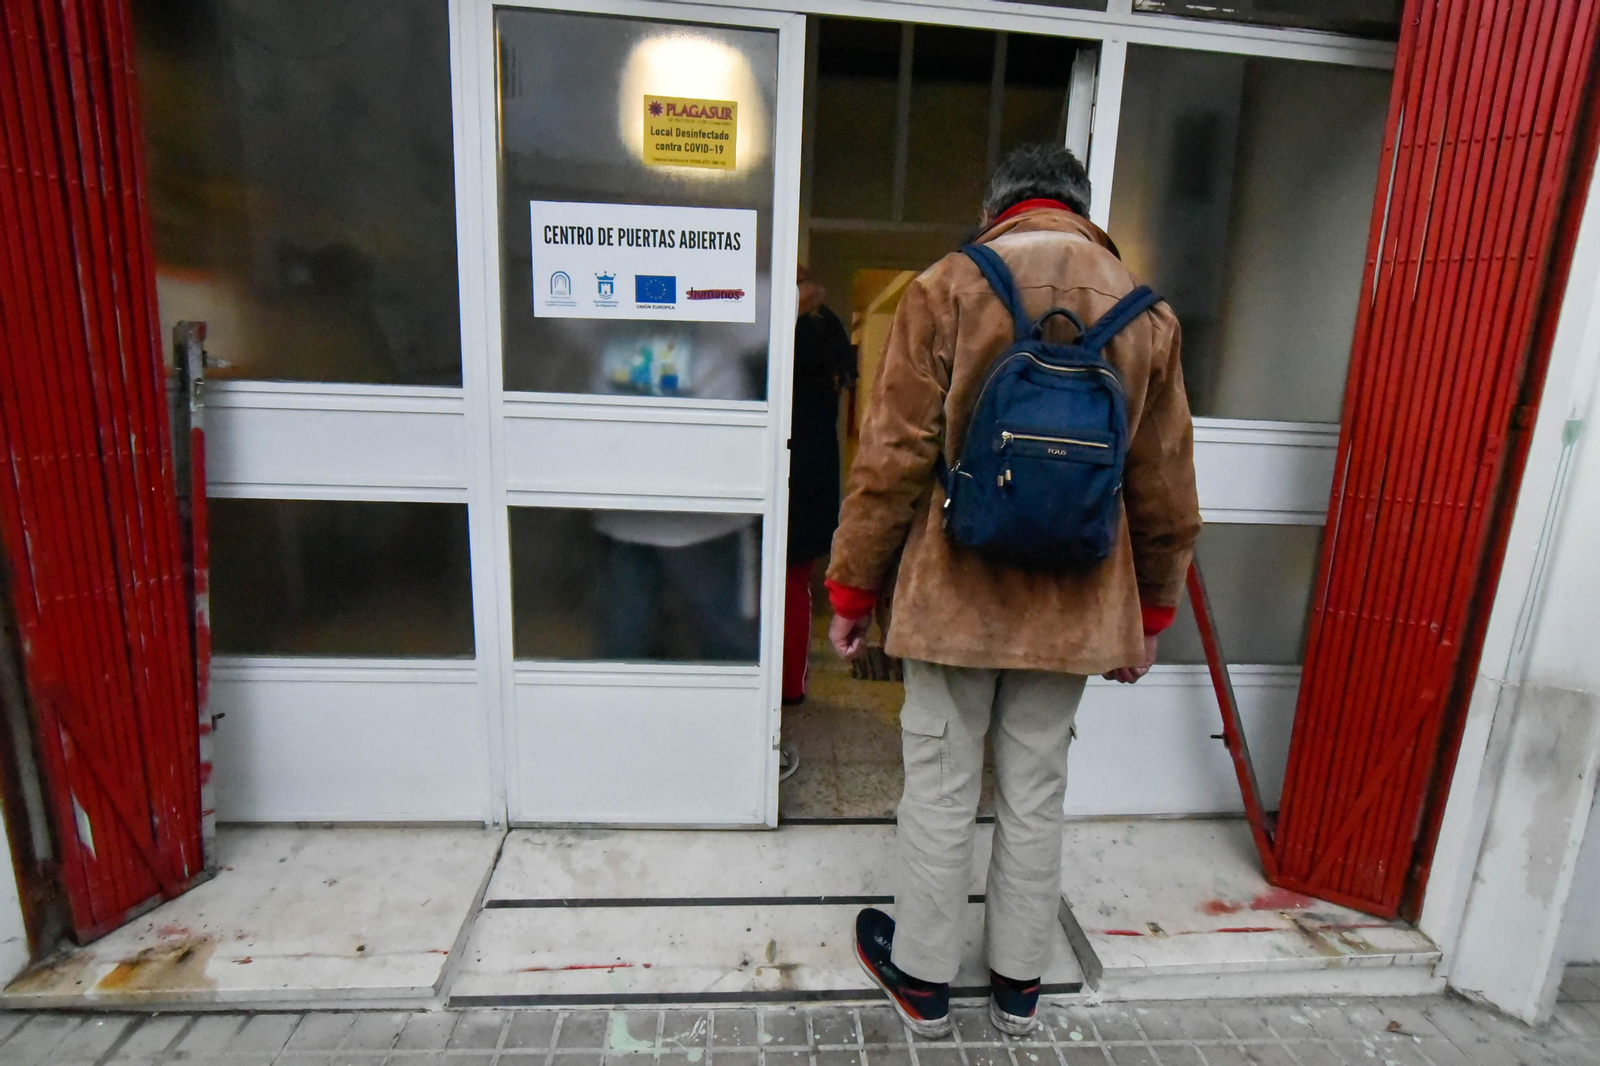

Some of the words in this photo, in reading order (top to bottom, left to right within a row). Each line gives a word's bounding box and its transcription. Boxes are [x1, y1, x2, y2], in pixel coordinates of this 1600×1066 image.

[665, 103, 733, 120] PLAGASUR
[650, 125, 673, 137] Local
[675, 127, 730, 140] Desinfectado
[655, 142, 682, 152] contra
[684, 143, 724, 154] COVID-19
[543, 225, 594, 246] CENTRO
[597, 227, 614, 246] DE
[618, 227, 676, 249] PUERTAS
[679, 230, 741, 251] ABIERTAS
[1047, 448, 1067, 456] TOUS
